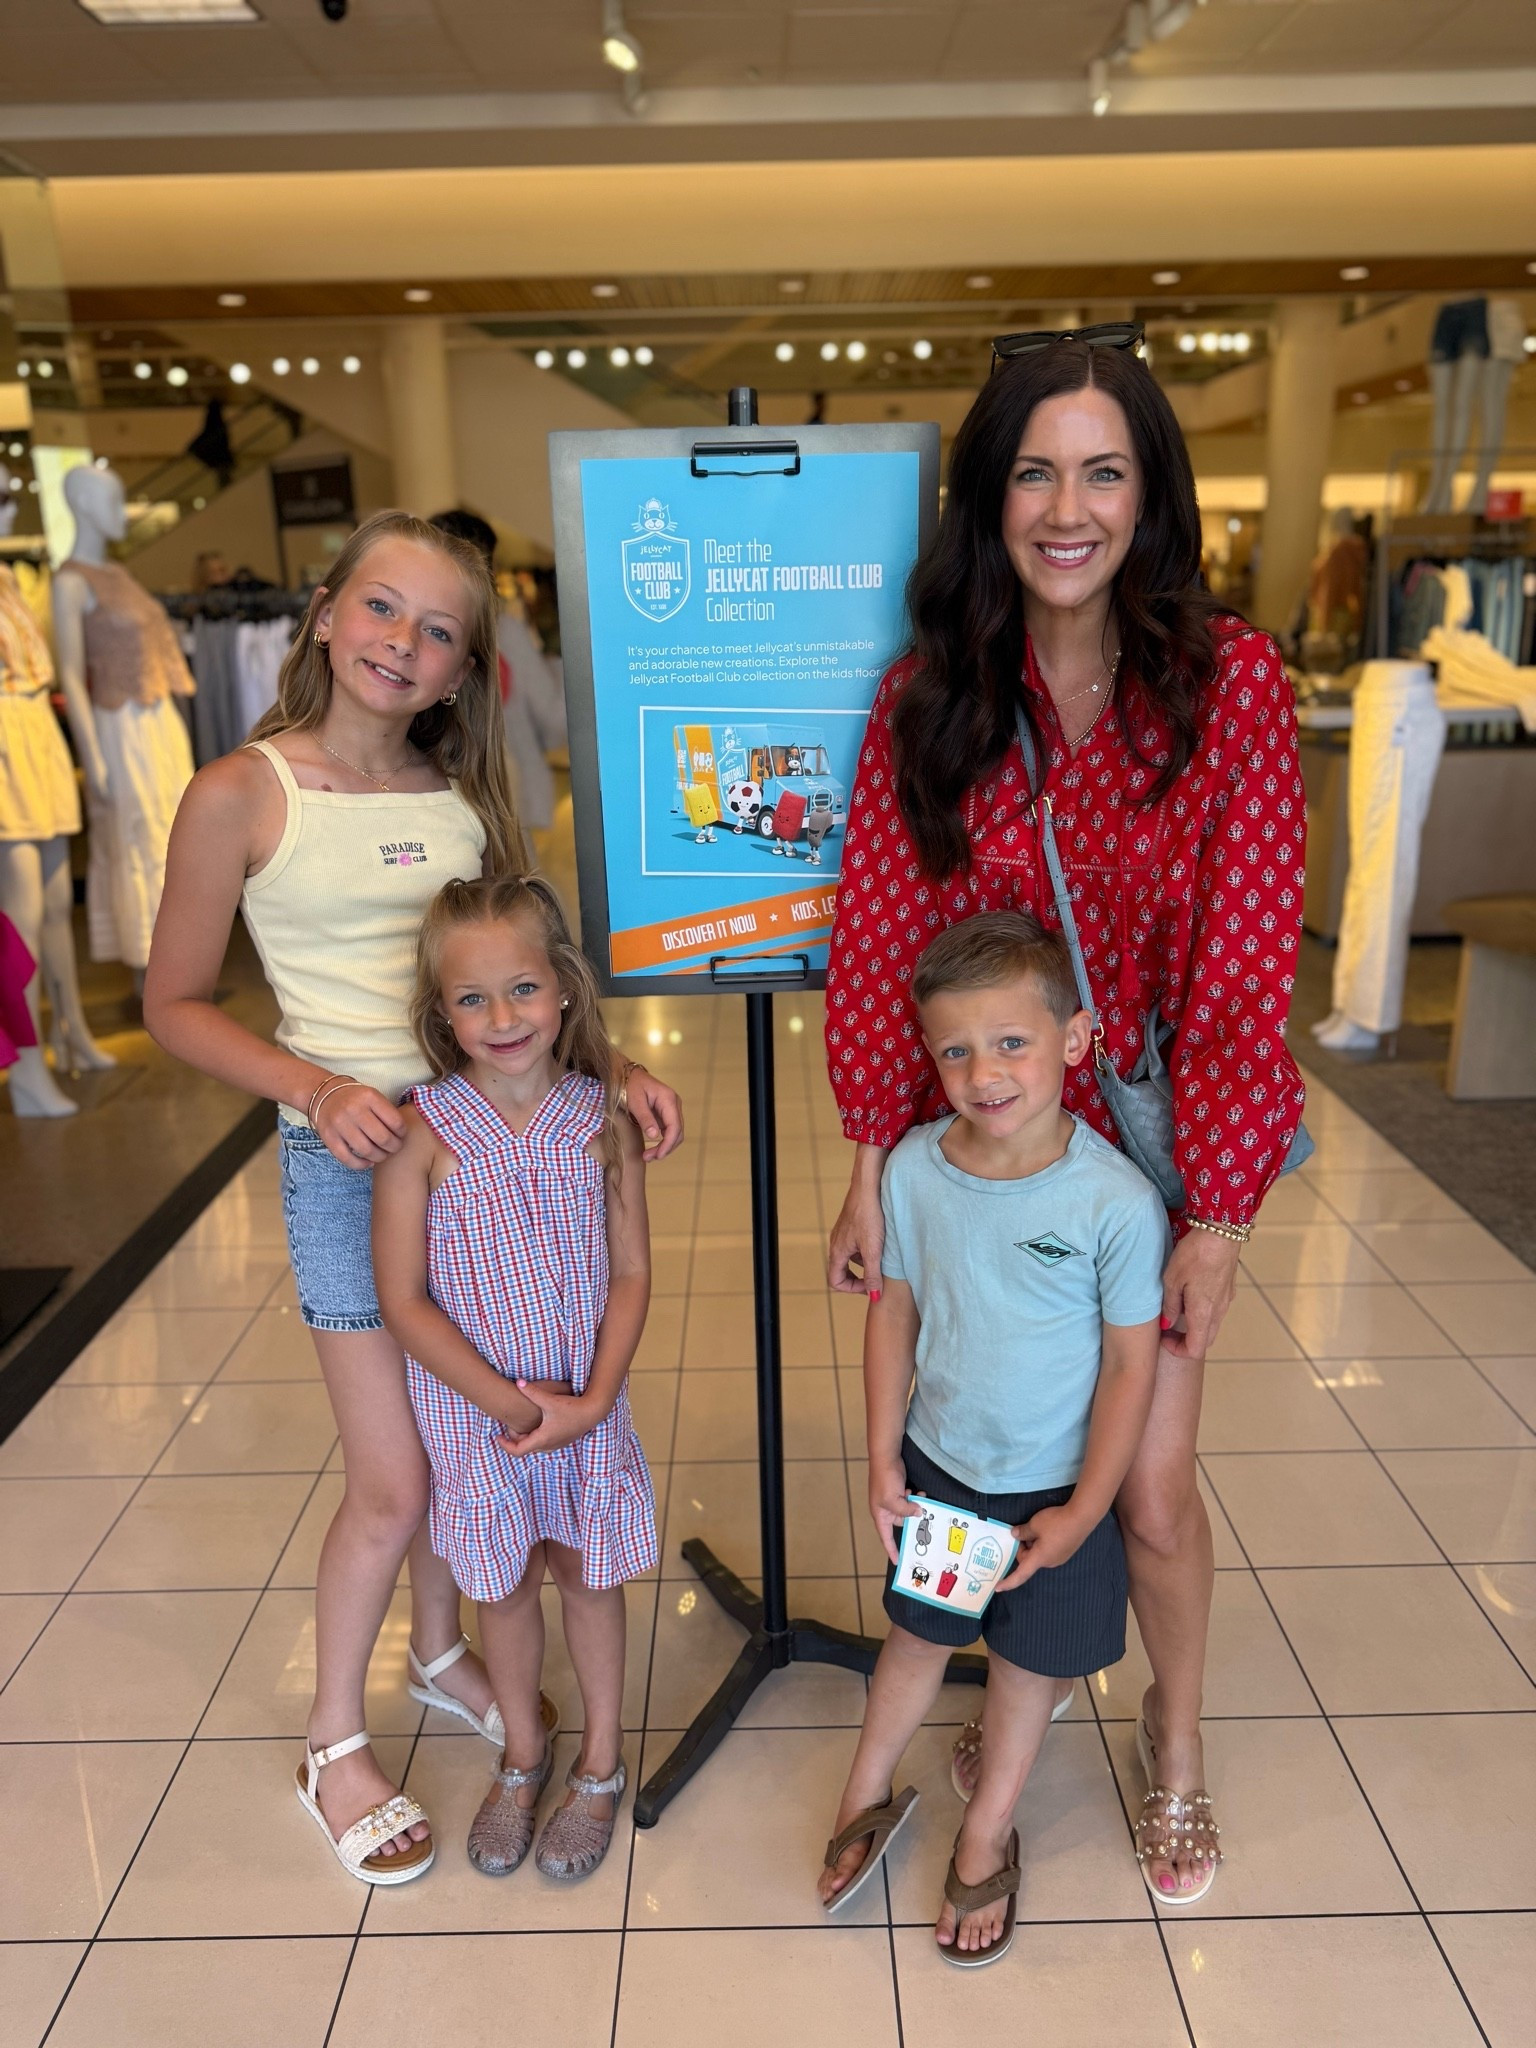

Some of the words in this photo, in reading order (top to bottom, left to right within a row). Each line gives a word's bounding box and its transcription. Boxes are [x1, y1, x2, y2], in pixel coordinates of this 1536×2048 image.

[704, 538, 743, 564] Meet
[746, 537, 772, 562] the
[630, 561, 683, 581] FOOTBALL
[705, 567, 769, 593] JELLYCAT
[773, 565, 844, 591] FOOTBALL
[848, 563, 882, 589] CLUB
[645, 581, 671, 600] CLUB
[706, 597, 775, 622] Collection
[645, 647, 668, 658] your
[670, 645, 709, 655] chance
[711, 645, 723, 654] to
[725, 644, 752, 653] meet
[803, 640, 875, 652] unmistakable
[629, 659, 649, 670] and
[651, 658, 699, 670] adorable
[701, 659, 723, 668] new
[724, 657, 777, 668] creations.
[779, 656, 819, 668] Explore
[821, 655, 838, 665] the
[630, 674, 668, 687] Jellycat
[670, 672, 714, 684] Football
[716, 671, 741, 682] Club
[742, 670, 795, 681] collection
[797, 671, 810, 680] on
[813, 669, 829, 679] the
[832, 668, 853, 679] kids
[855, 667, 880, 678] floor
[379, 842, 425, 856] PARADISE
[662, 922, 716, 951] DISCOVER
[716, 919, 728, 938] IT
[730, 913, 758, 936] NOW
[790, 899, 823, 922] KIDS,
[821, 895, 837, 915] LE
